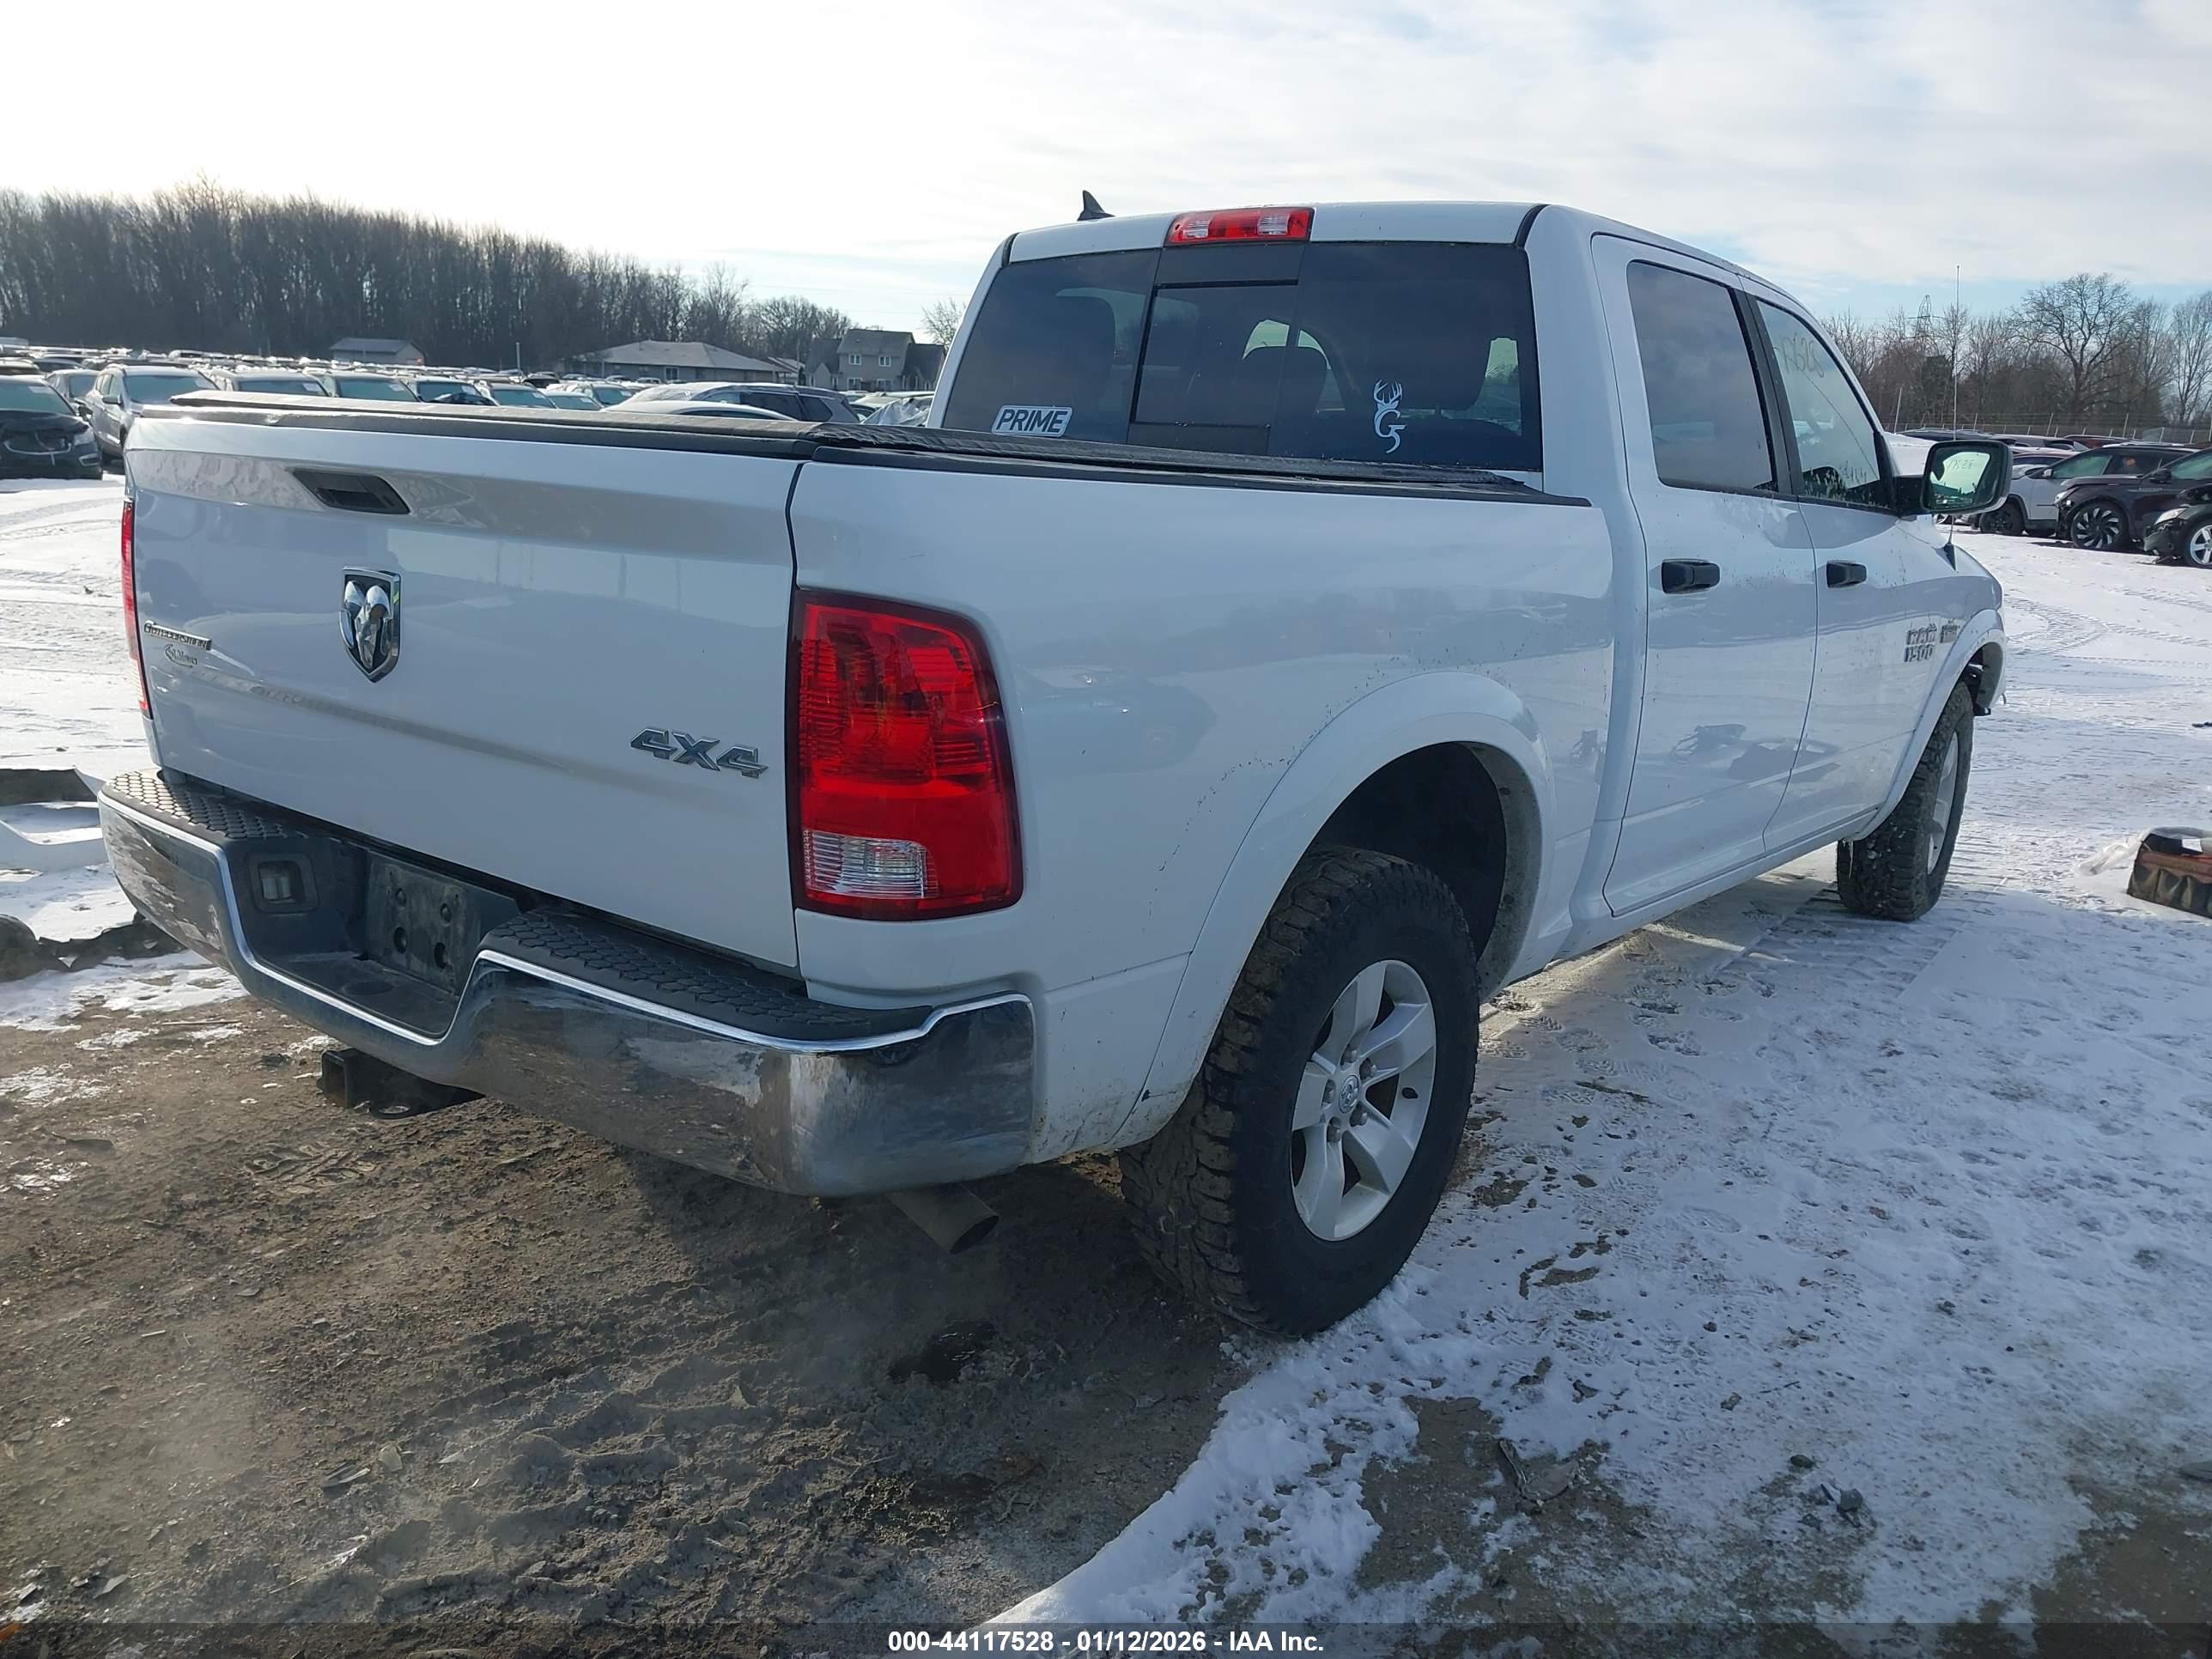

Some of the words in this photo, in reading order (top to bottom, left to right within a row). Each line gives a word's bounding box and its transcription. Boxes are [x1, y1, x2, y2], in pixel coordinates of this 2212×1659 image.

[995, 409, 1069, 433] PRIME
[1906, 623, 1937, 645] RAM
[1903, 644, 1935, 663] 1500
[629, 727, 769, 779] 4X4
